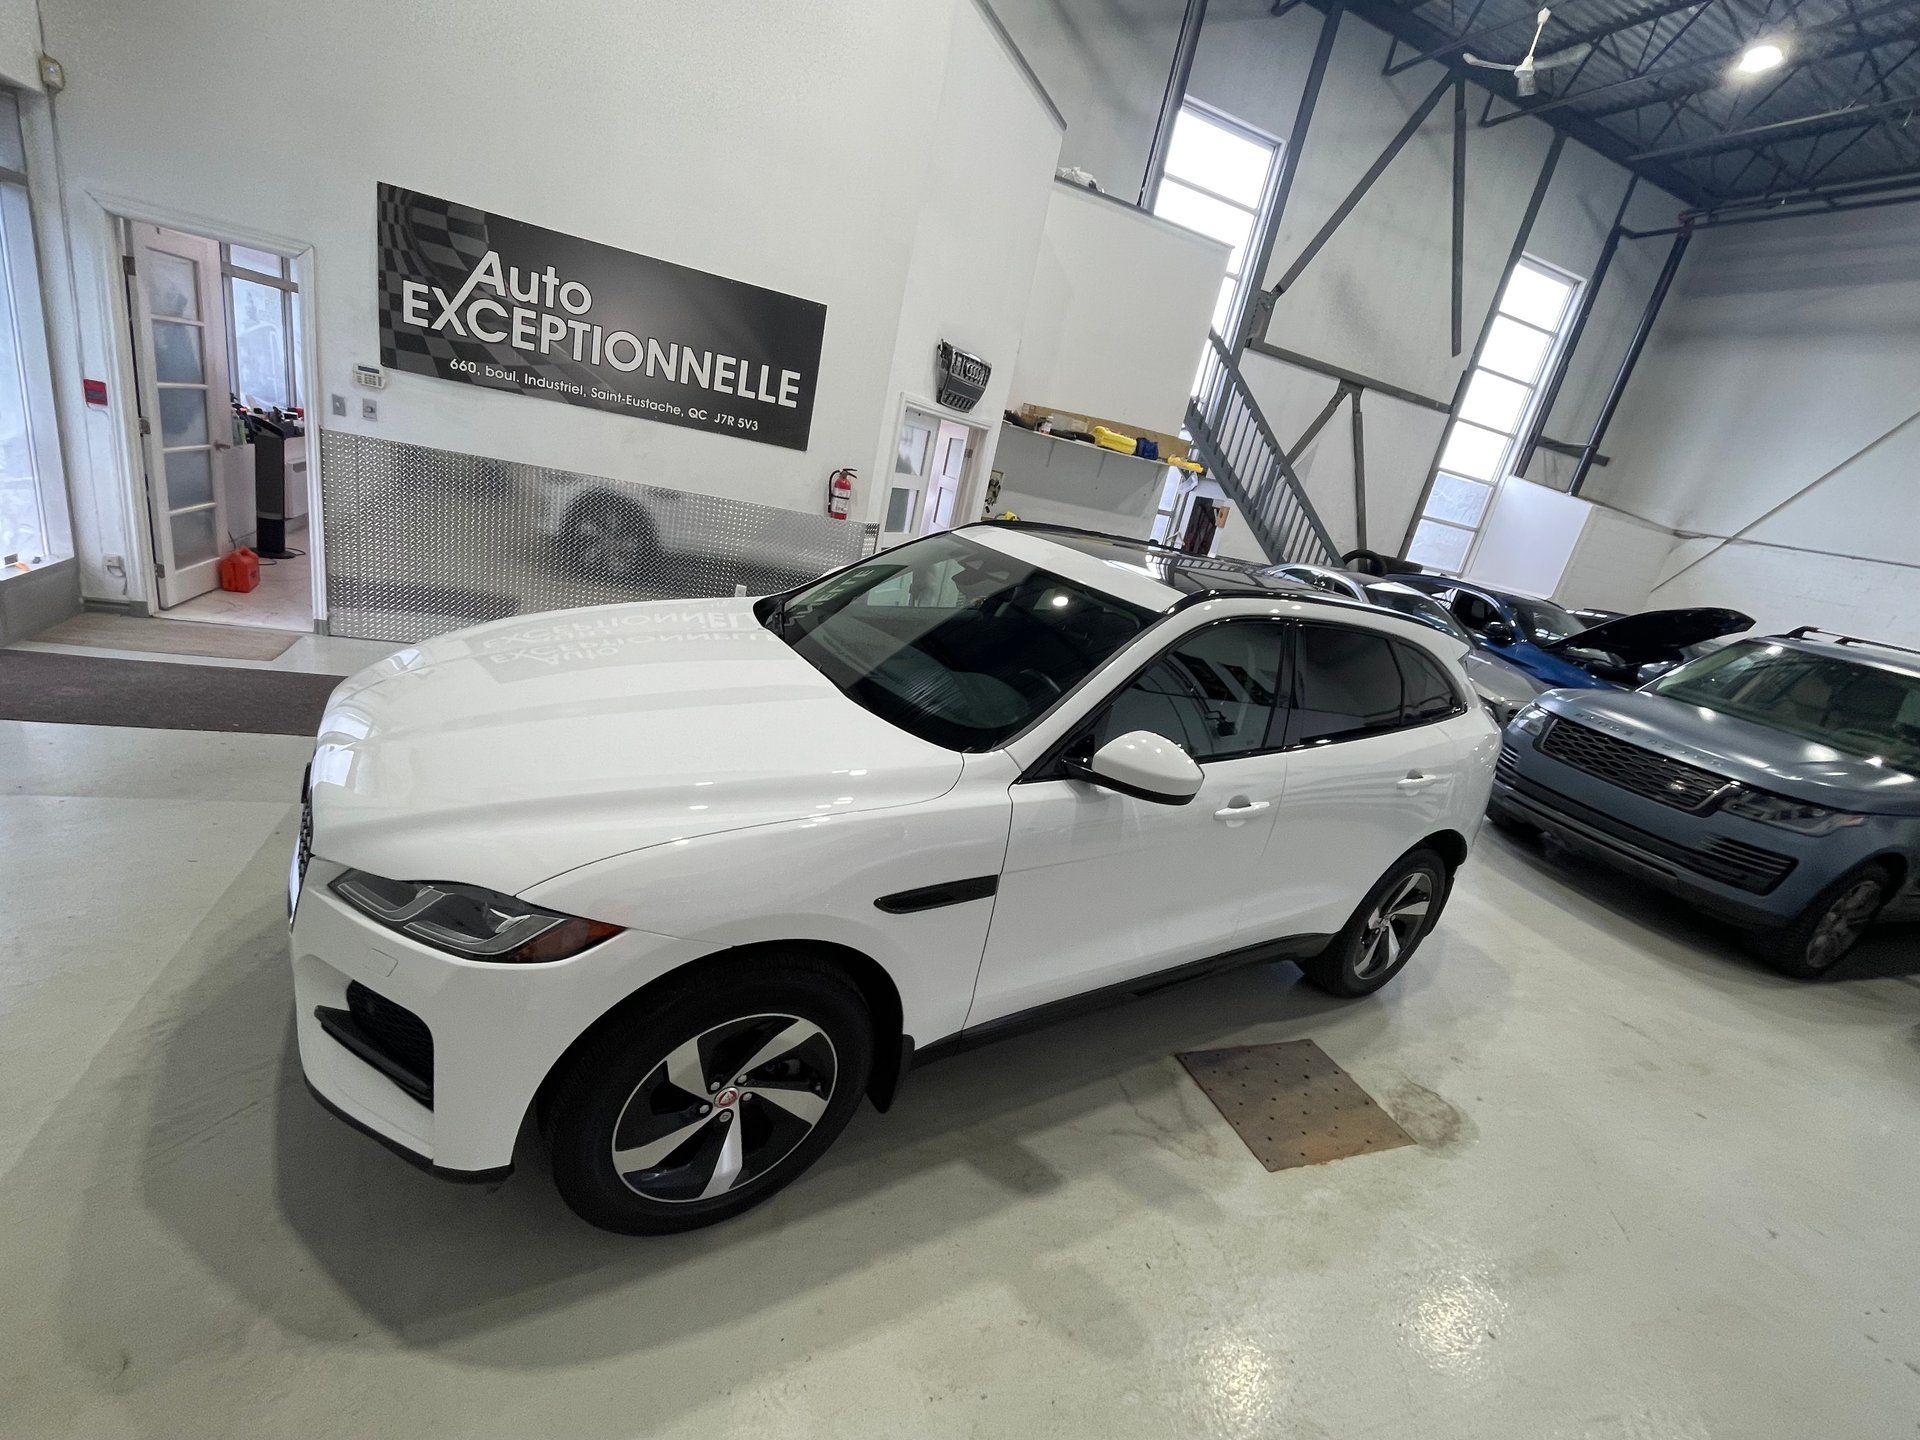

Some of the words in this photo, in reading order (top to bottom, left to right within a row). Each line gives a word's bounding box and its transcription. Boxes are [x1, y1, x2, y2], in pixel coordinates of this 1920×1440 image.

[460, 250, 593, 316] Auto
[402, 279, 801, 409] EXCEPTIONNELLE
[450, 358, 481, 376] 660,
[485, 365, 520, 383] boul.
[524, 373, 587, 397] Industriel,
[590, 387, 684, 417] Saint-Eustache,
[688, 407, 708, 421] QC
[713, 413, 734, 427] J7R
[737, 418, 759, 431] 5V3
